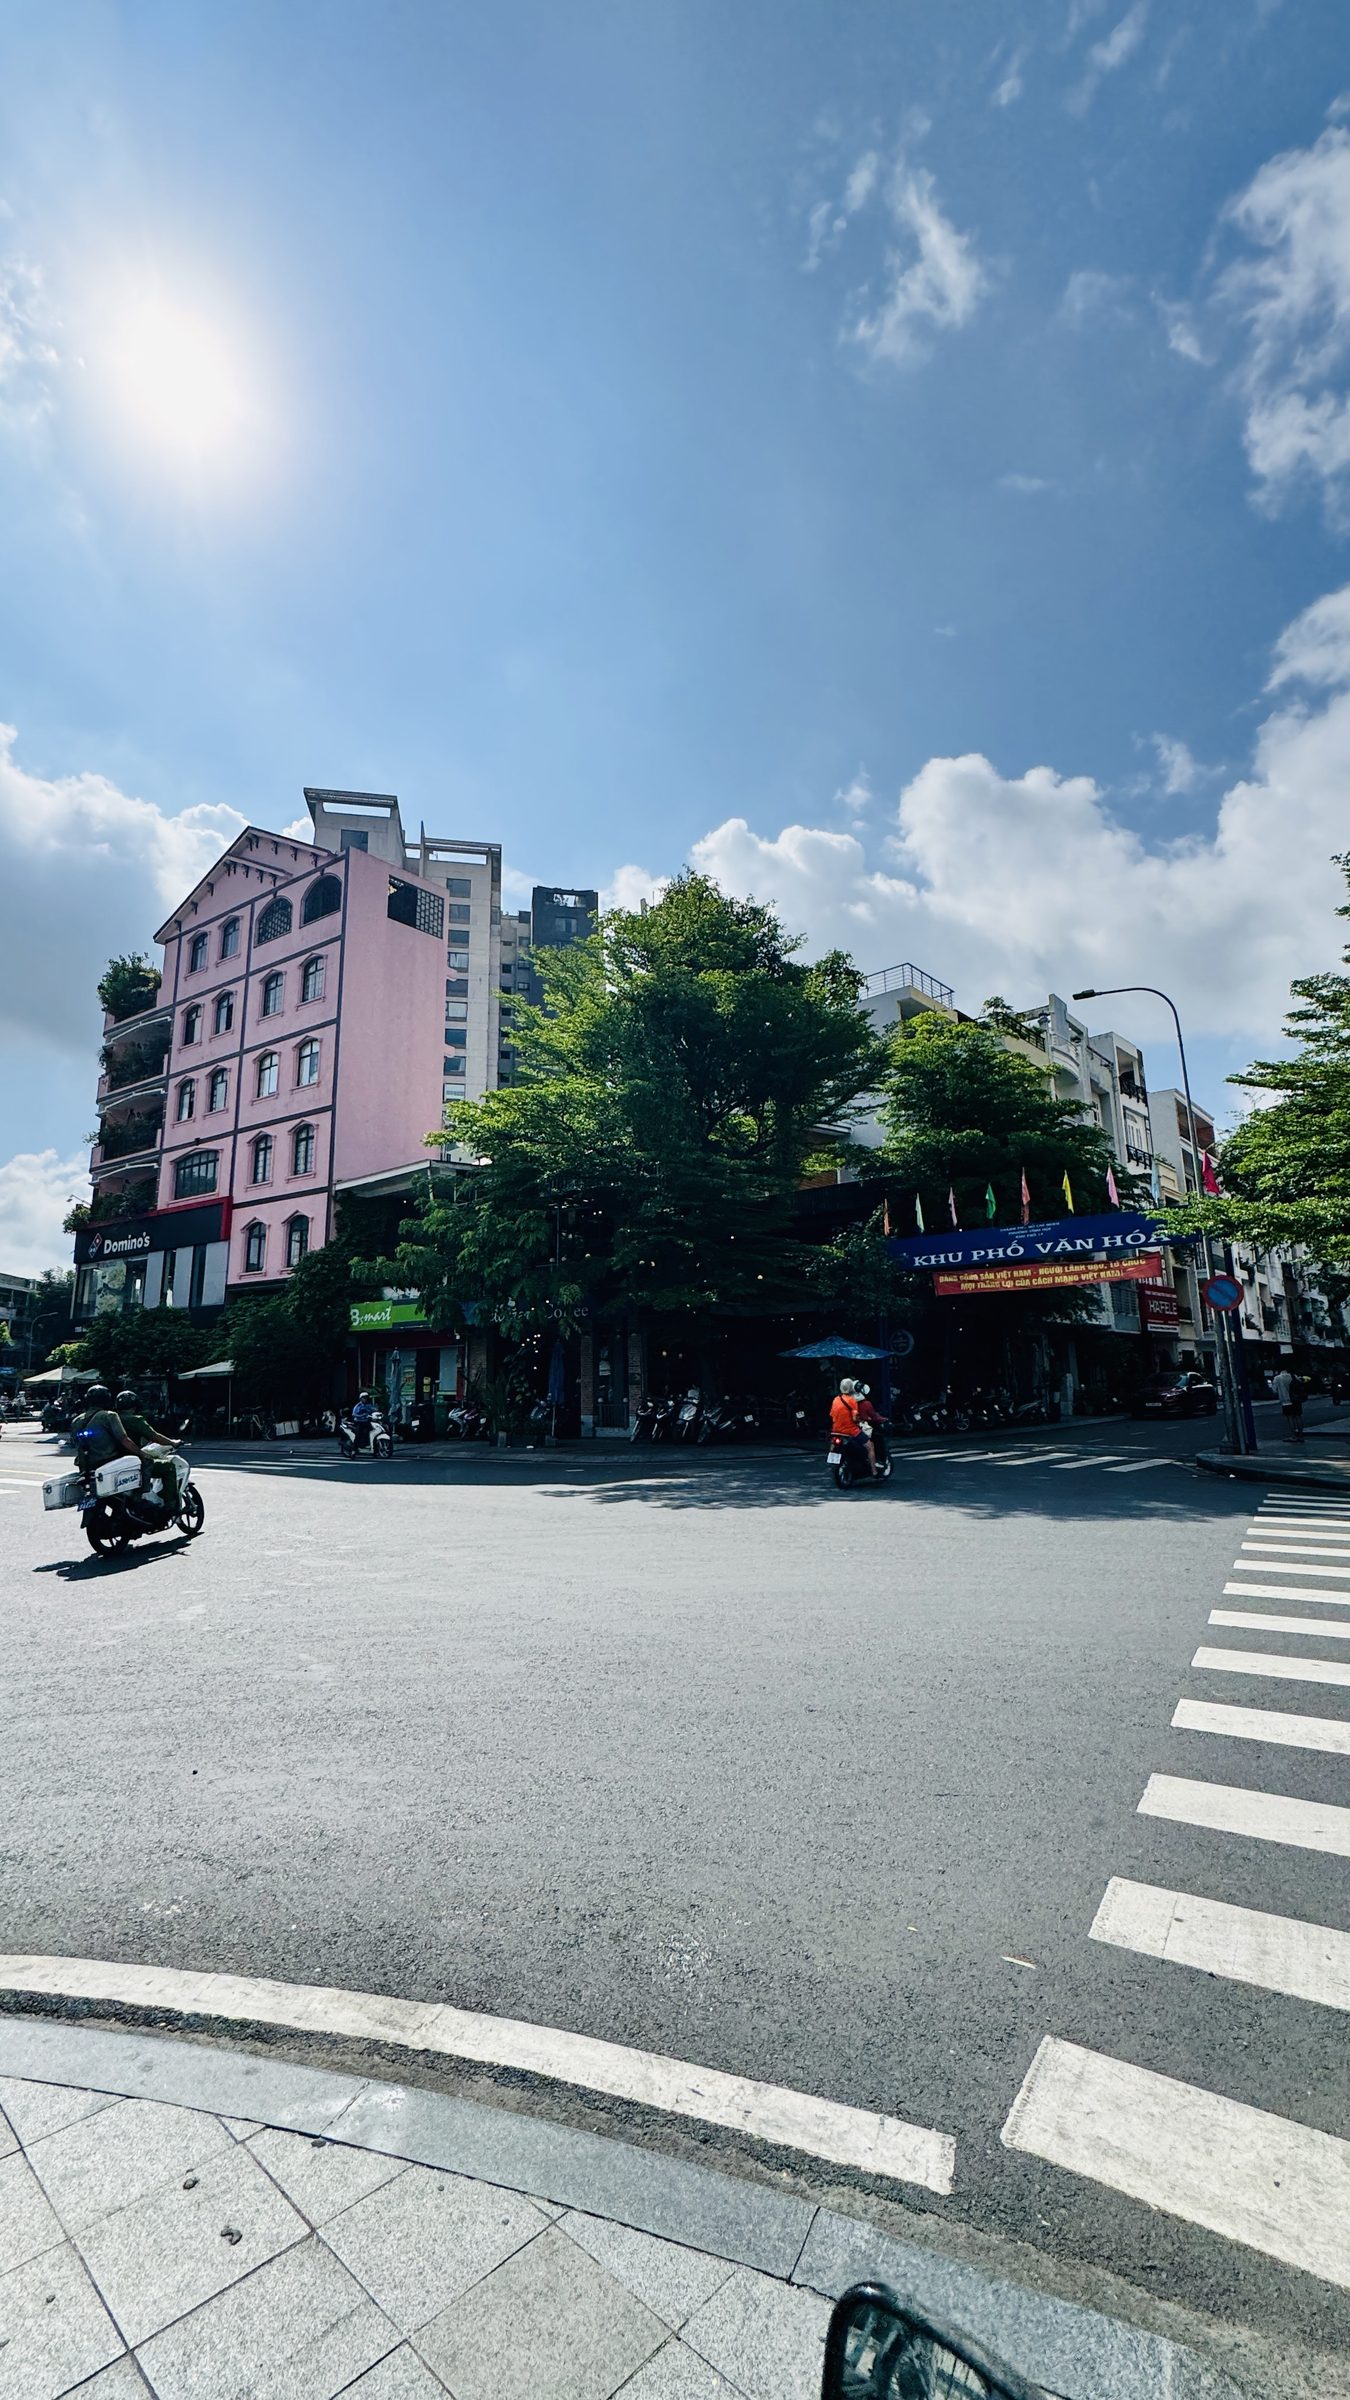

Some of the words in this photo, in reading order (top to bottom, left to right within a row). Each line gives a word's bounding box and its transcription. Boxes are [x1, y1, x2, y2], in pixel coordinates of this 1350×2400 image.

[103, 1231, 151, 1255] Domino's
[913, 1251, 963, 1267] KHU
[971, 1239, 1025, 1261] PHỐ
[1035, 1237, 1095, 1254] VĂN
